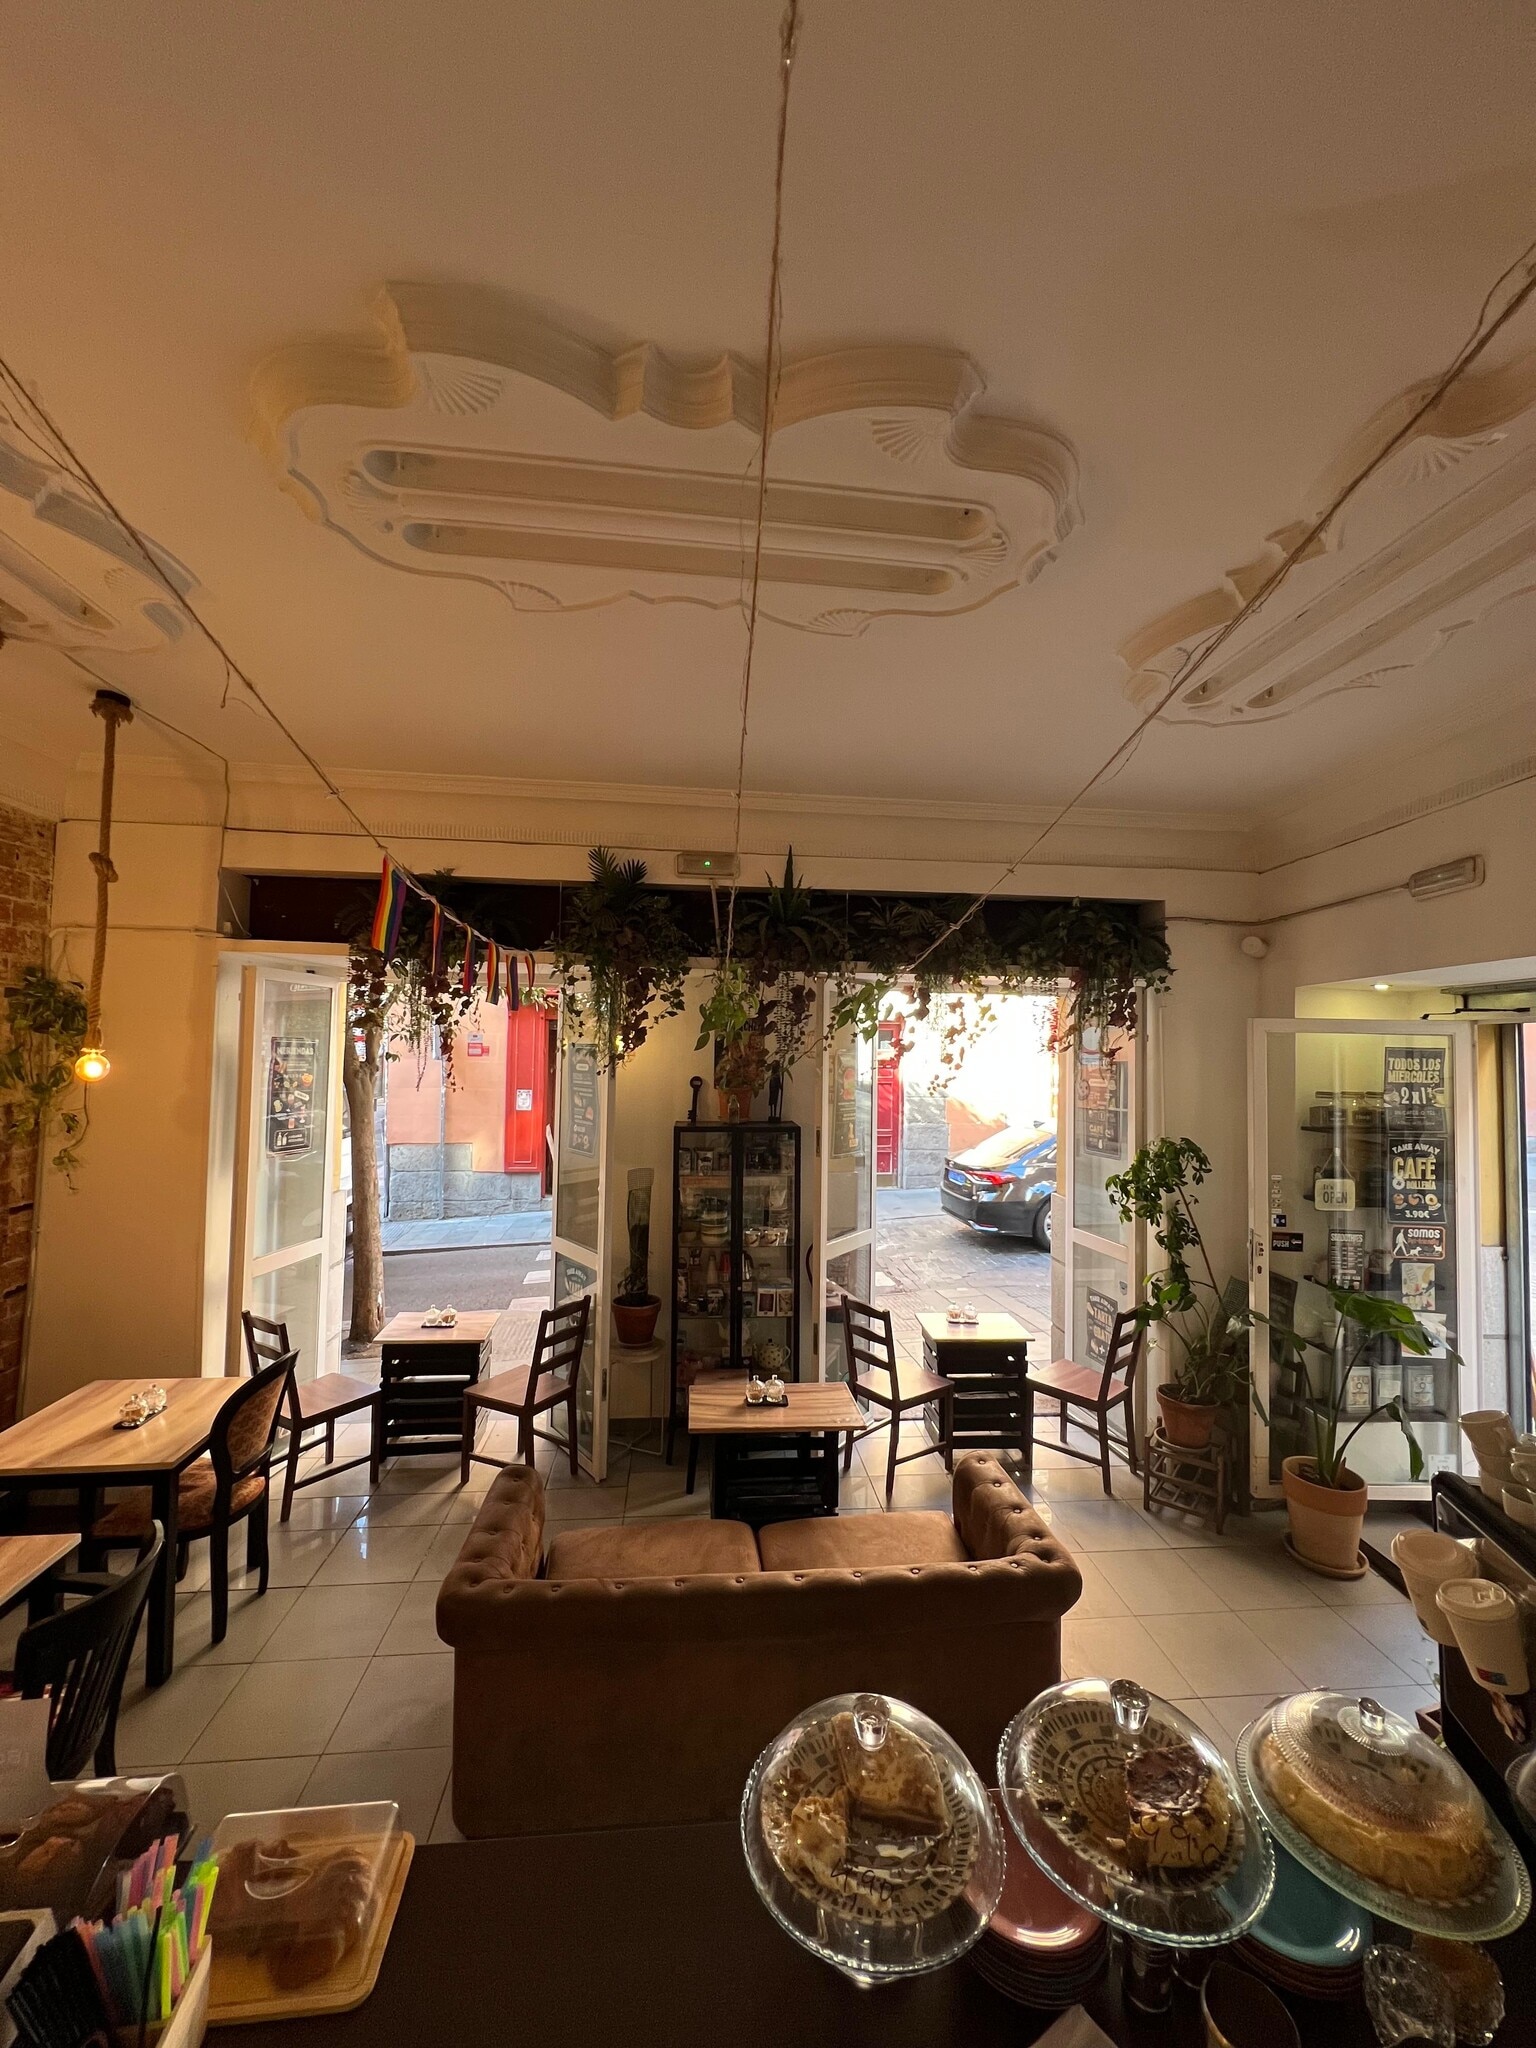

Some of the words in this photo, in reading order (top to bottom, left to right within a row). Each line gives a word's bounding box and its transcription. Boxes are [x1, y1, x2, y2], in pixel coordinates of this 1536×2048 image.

[1388, 1058, 1420, 1071] TODOS
[1422, 1058, 1441, 1071] LOS
[1392, 1143, 1413, 1153] TAKE
[1414, 1143, 1440, 1155] AWAY
[1392, 1153, 1436, 1179] CAFÉ
[1322, 1192, 1348, 1204] OPEN
[1272, 1240, 1290, 1248] PUSH
